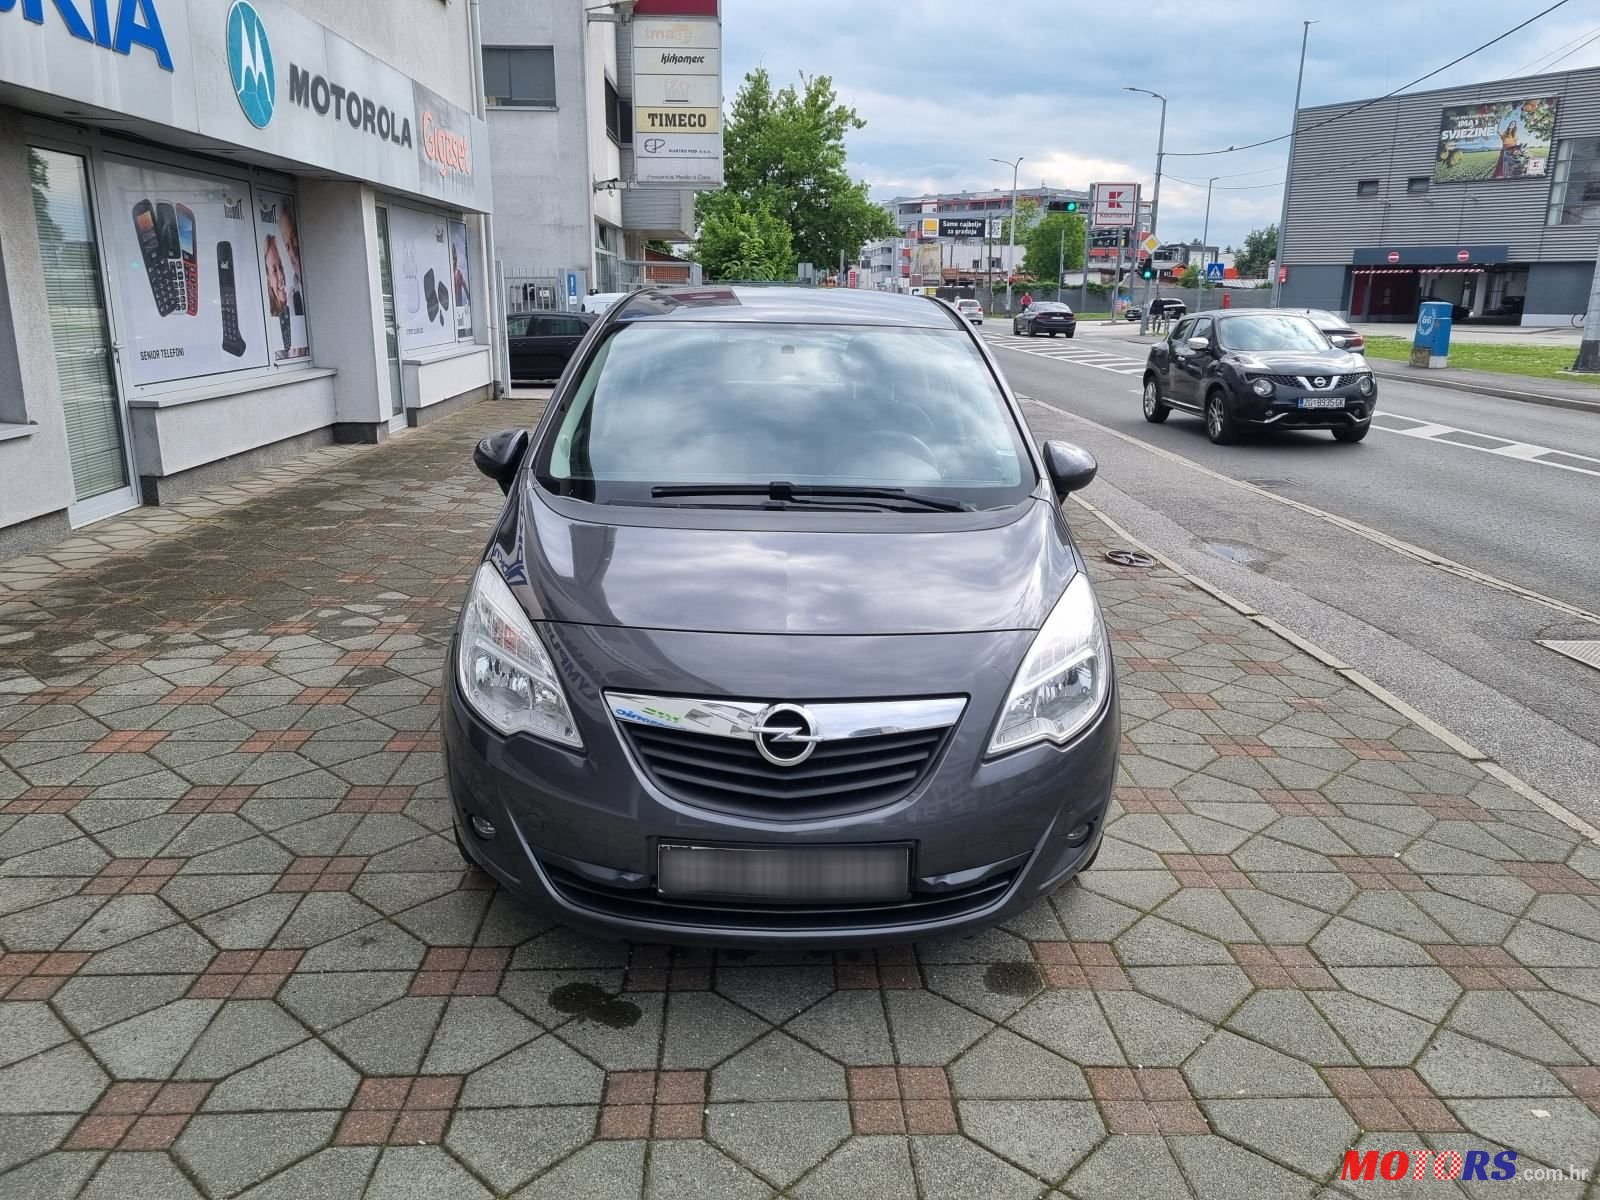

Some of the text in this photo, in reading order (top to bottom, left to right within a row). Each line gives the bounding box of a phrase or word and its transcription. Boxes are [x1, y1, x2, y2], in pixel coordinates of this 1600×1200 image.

[661, 53, 705, 65] kirkomerc
[289, 63, 413, 150] MOTOROLA
[648, 112, 707, 128] TIMECO
[1441, 123, 1499, 140] SVJEŽINE!
[422, 111, 475, 177] Gigaset
[140, 350, 160, 361] SENIOR
